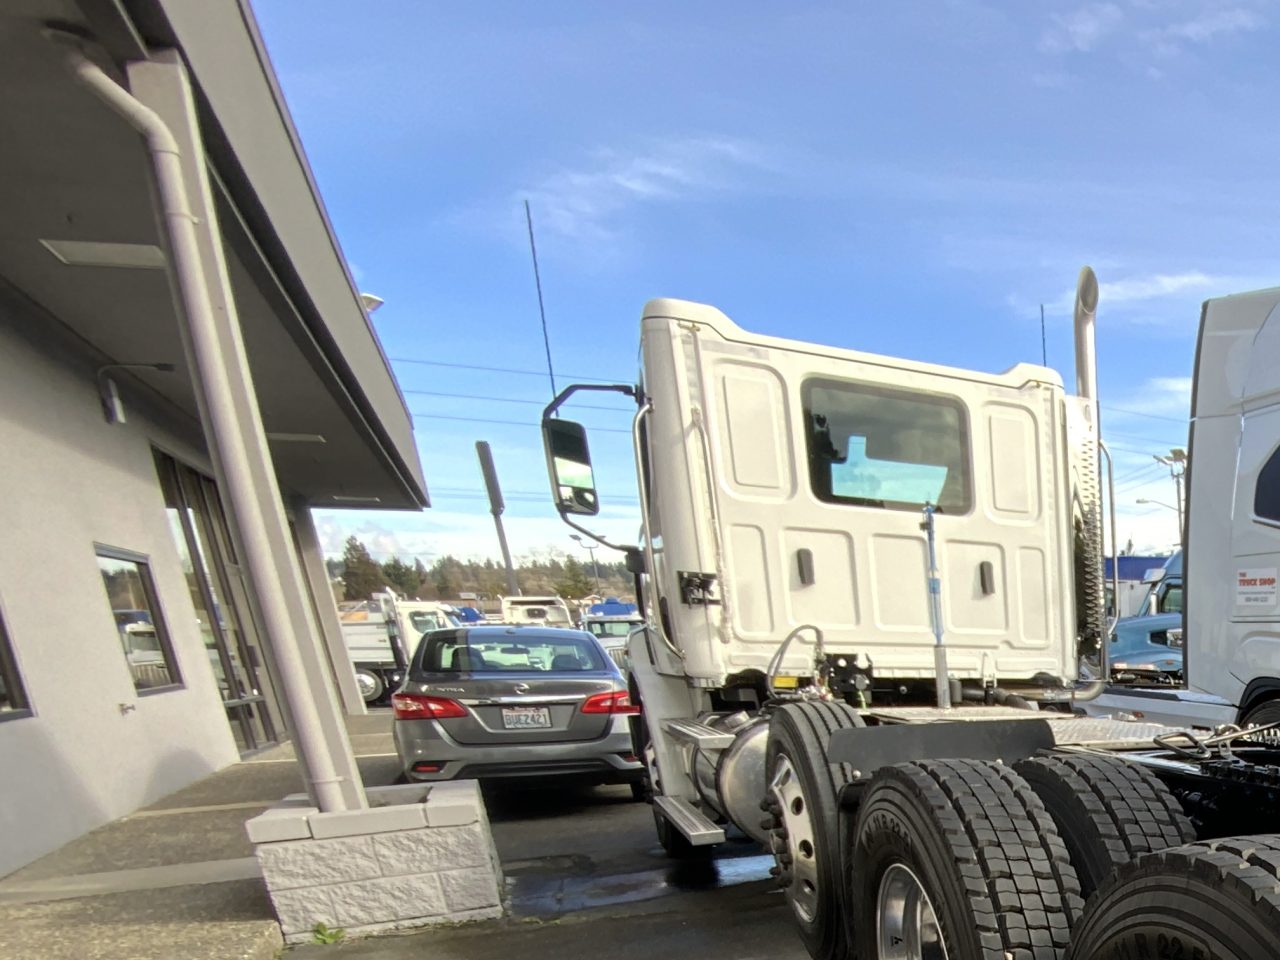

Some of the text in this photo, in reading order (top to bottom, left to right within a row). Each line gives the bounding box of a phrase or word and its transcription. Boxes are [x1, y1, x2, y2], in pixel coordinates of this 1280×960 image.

[1239, 577, 1276, 587] TRUCK SHOP
[421, 684, 465, 693] NTRA
